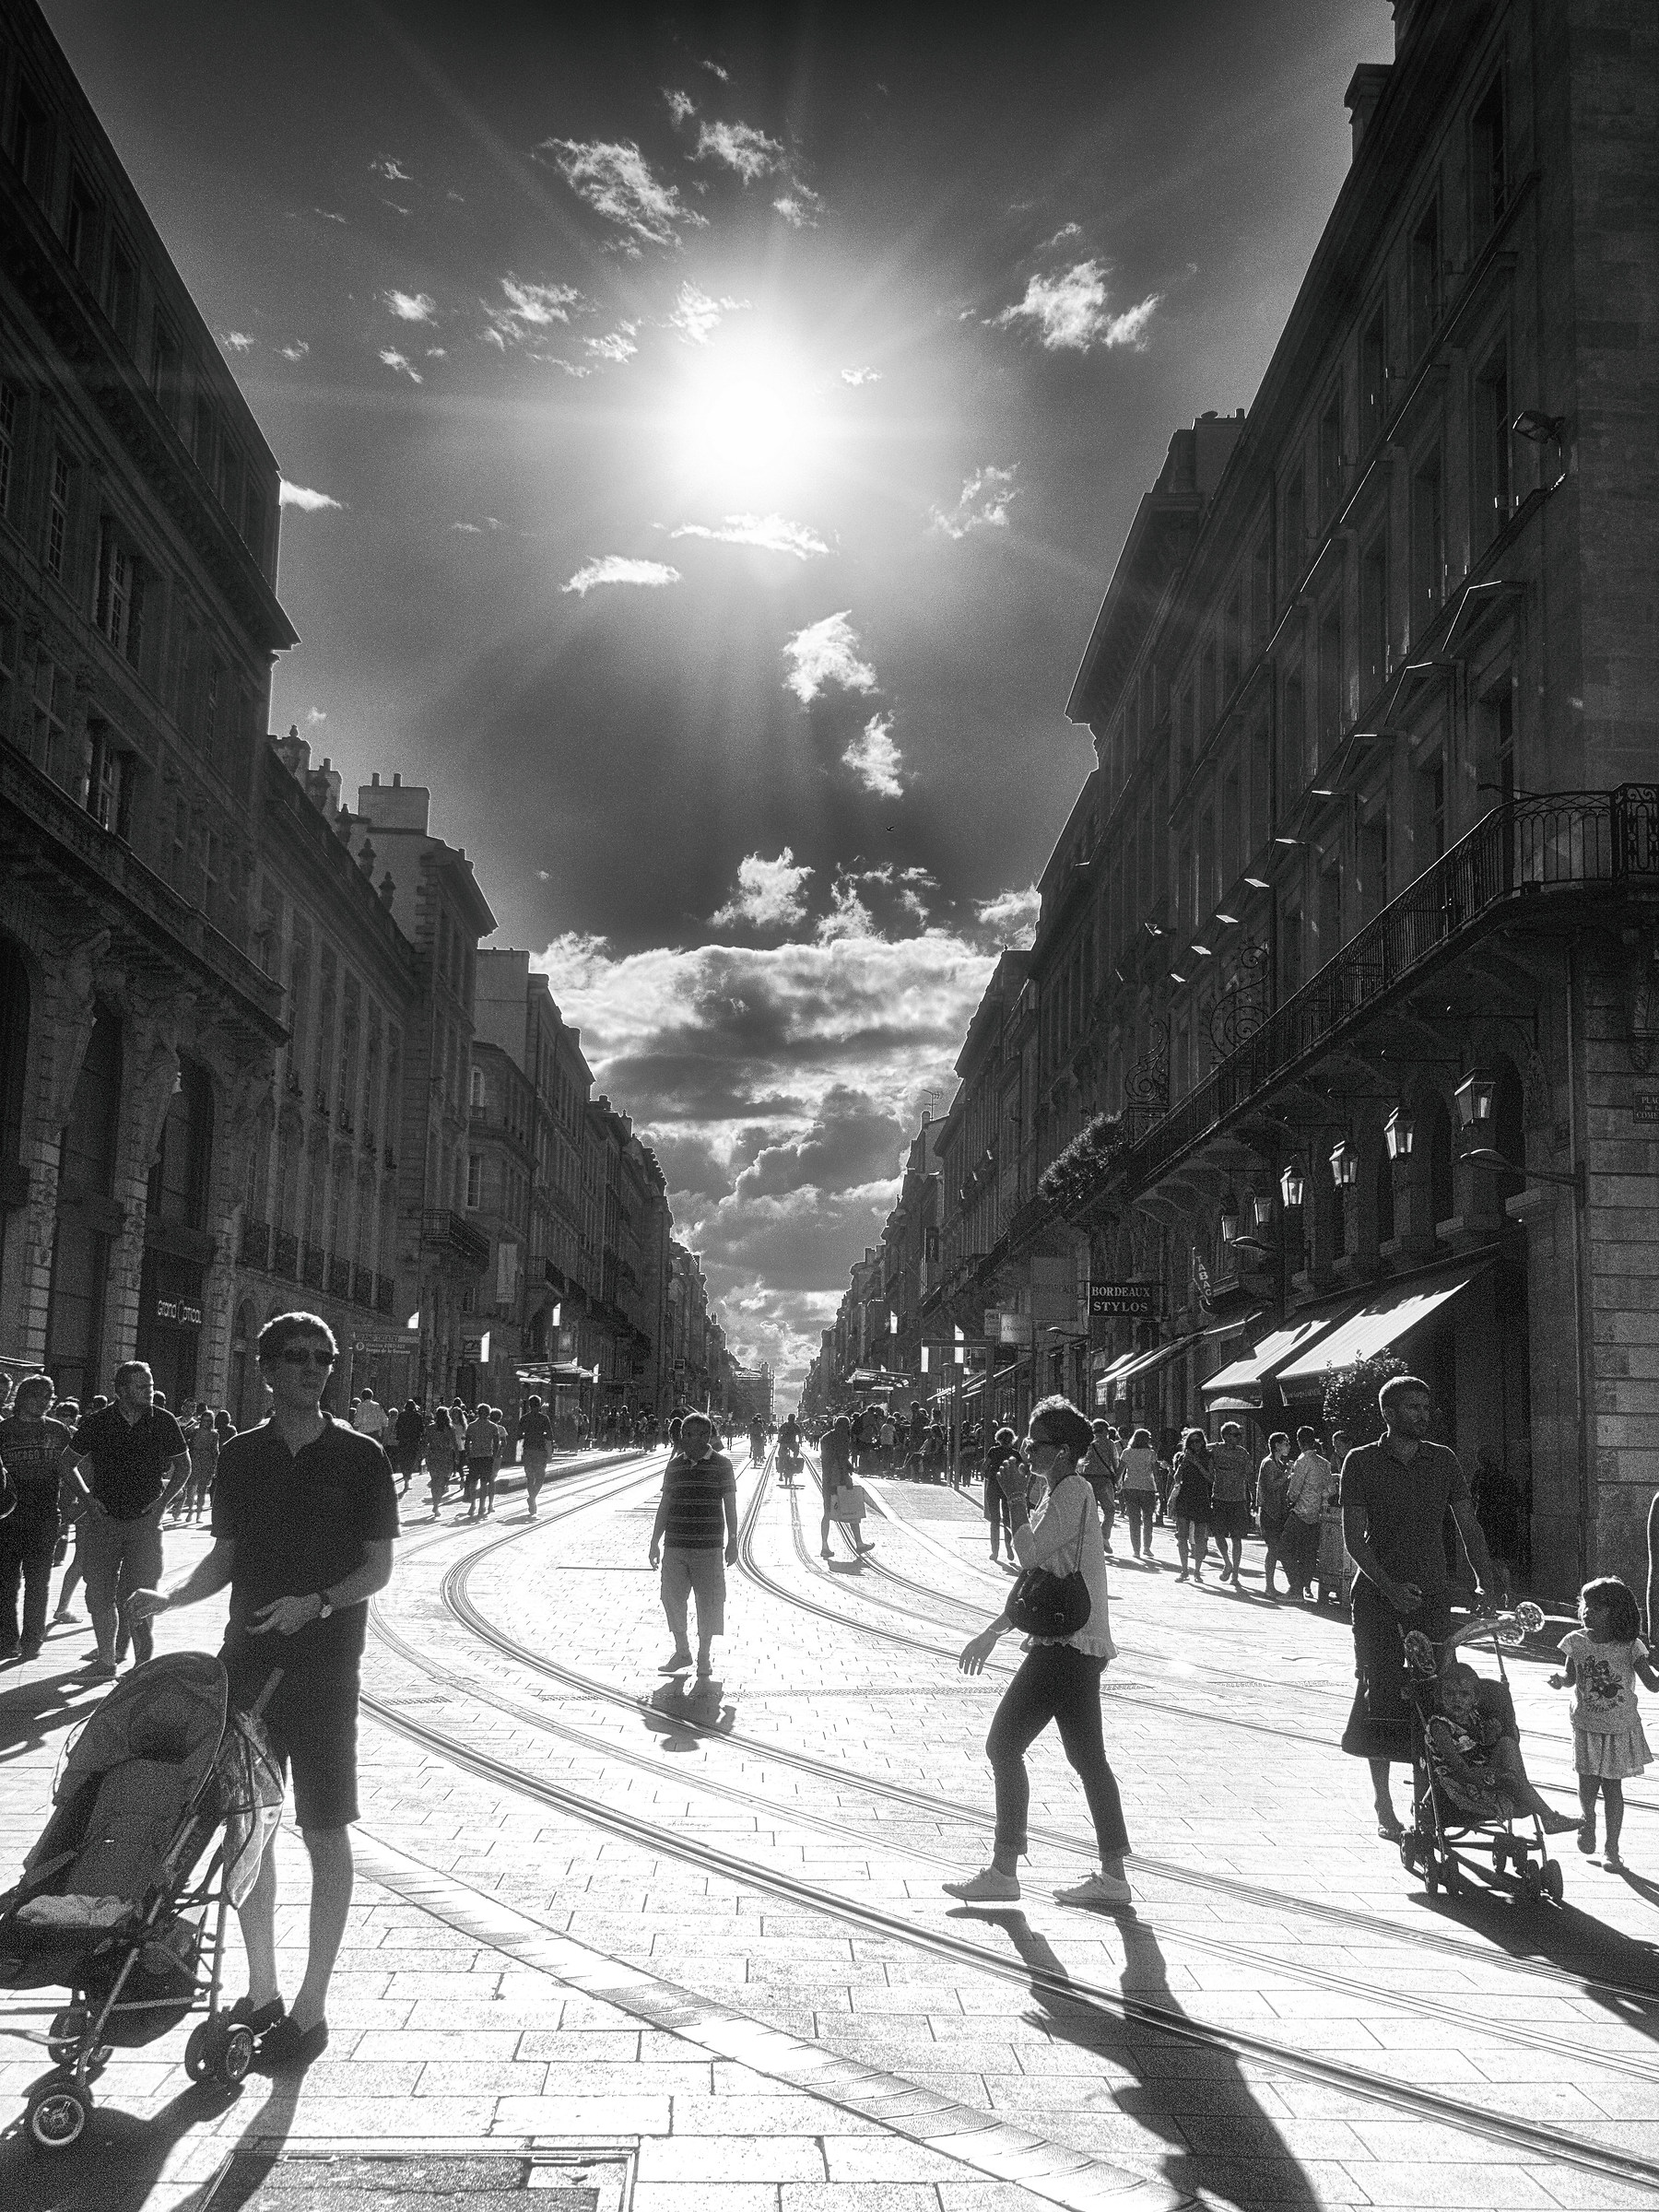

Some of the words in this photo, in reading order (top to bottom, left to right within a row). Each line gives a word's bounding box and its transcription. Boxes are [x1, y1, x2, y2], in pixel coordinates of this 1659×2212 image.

[1195, 1255, 1212, 1297] TABAC
[1090, 1286, 1151, 1298] BORDEAUX
[1093, 1300, 1148, 1312] STYLOS
